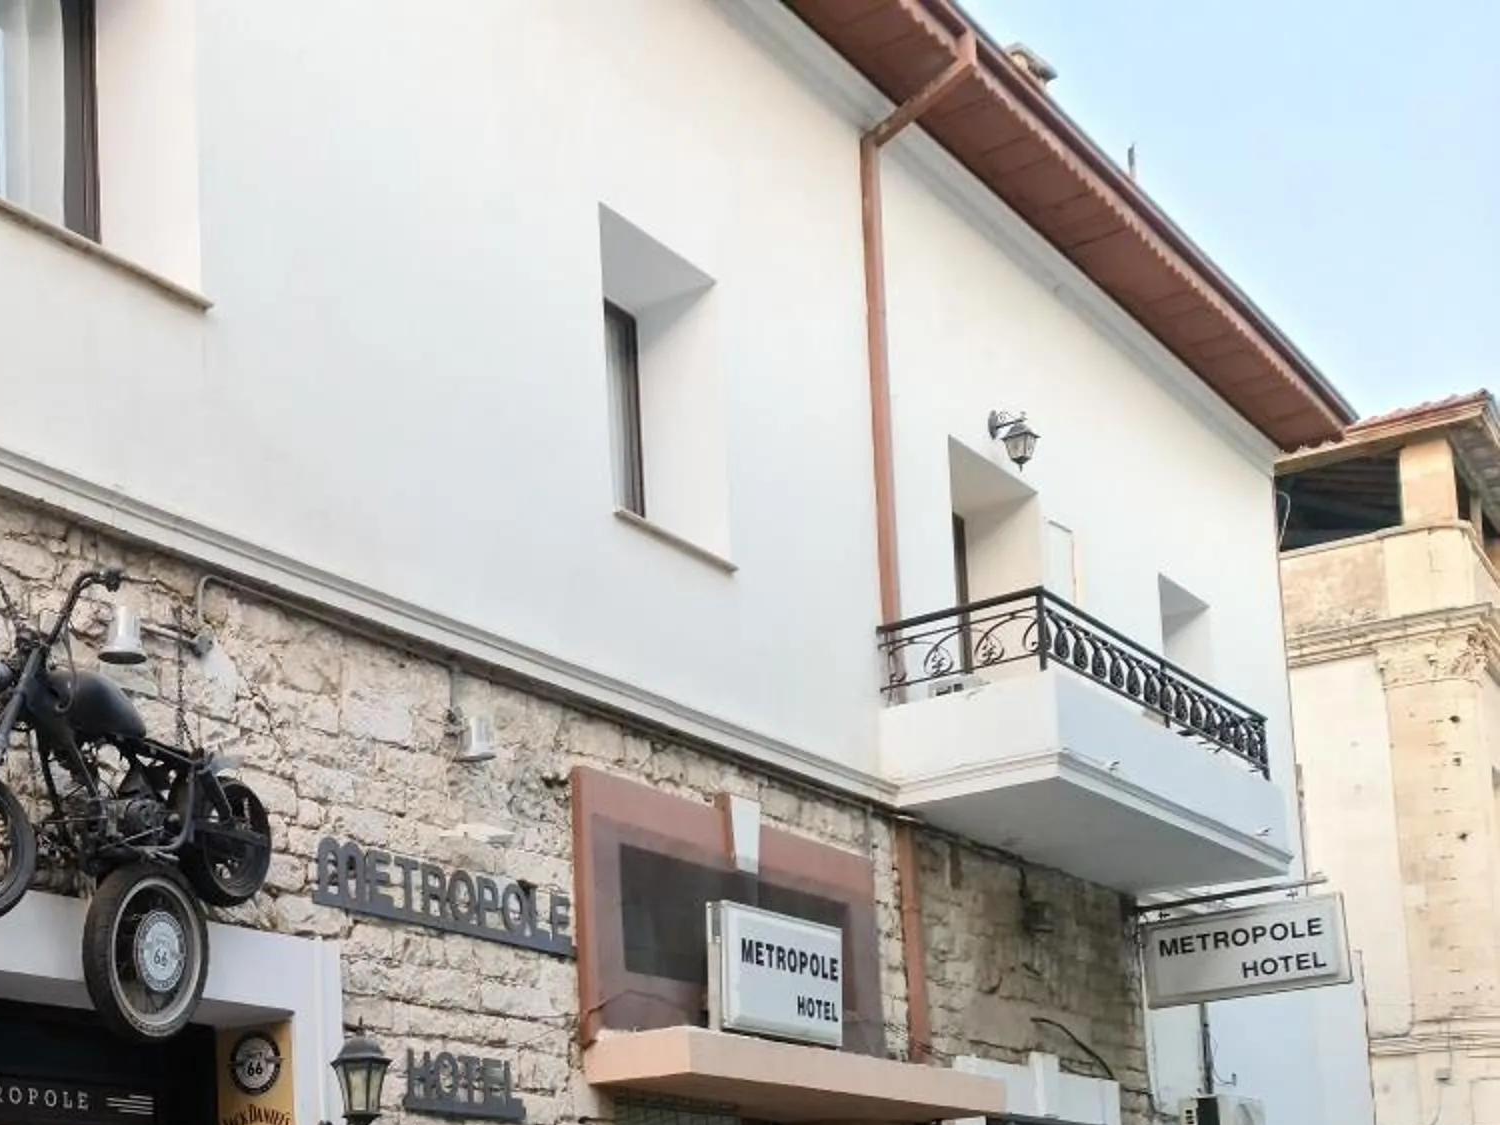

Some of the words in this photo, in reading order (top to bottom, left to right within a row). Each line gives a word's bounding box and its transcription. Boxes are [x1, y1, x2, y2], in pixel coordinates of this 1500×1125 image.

[316, 836, 573, 945] METROPOLE
[1158, 917, 1324, 957] METROPOLE
[740, 936, 840, 982] METROPOLE
[1242, 951, 1327, 979] HOTEL
[796, 995, 839, 1023] HOTEL
[406, 1047, 523, 1106] HOTEL
